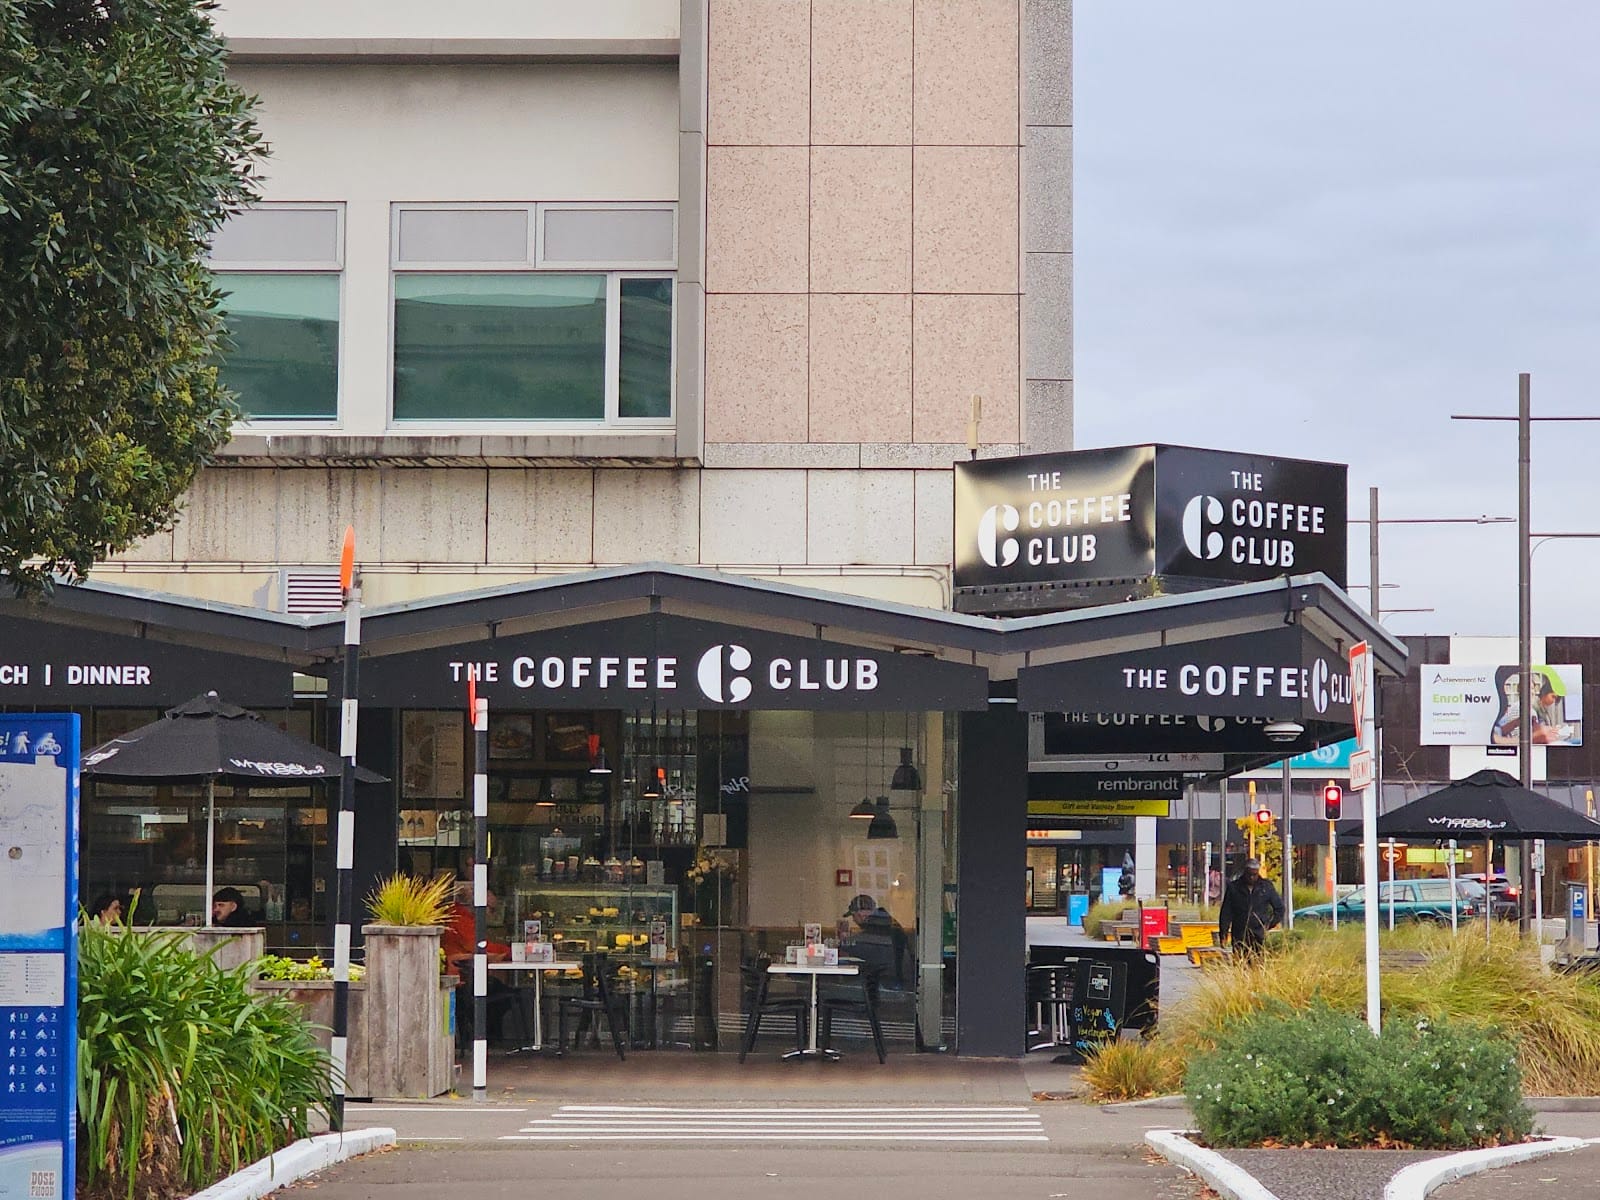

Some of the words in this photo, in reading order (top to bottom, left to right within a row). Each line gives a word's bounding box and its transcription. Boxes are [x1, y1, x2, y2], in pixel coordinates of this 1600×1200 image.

[1028, 472, 1062, 492] THE
[1231, 471, 1263, 492] THE
[1028, 494, 1131, 529] COFFEE
[1231, 498, 1325, 534] COFFEE
[1028, 534, 1097, 566] CLUB
[1231, 536, 1295, 567] CLUB
[67, 665, 151, 685] DINNER
[449, 662, 498, 682] THE
[512, 656, 677, 689] COFFEE
[769, 658, 878, 690] CLUB
[1123, 668, 1167, 689] THE
[1179, 664, 1308, 699] COFFEE
[1331, 673, 1352, 705] CLU
[1432, 693, 1463, 704] Enrol
[1464, 693, 1492, 704] Now
[1062, 712, 1089, 723] THE
[1097, 777, 1179, 791] rembrandt
[1116, 803, 1136, 811] Store
[1573, 891, 1584, 904] P
